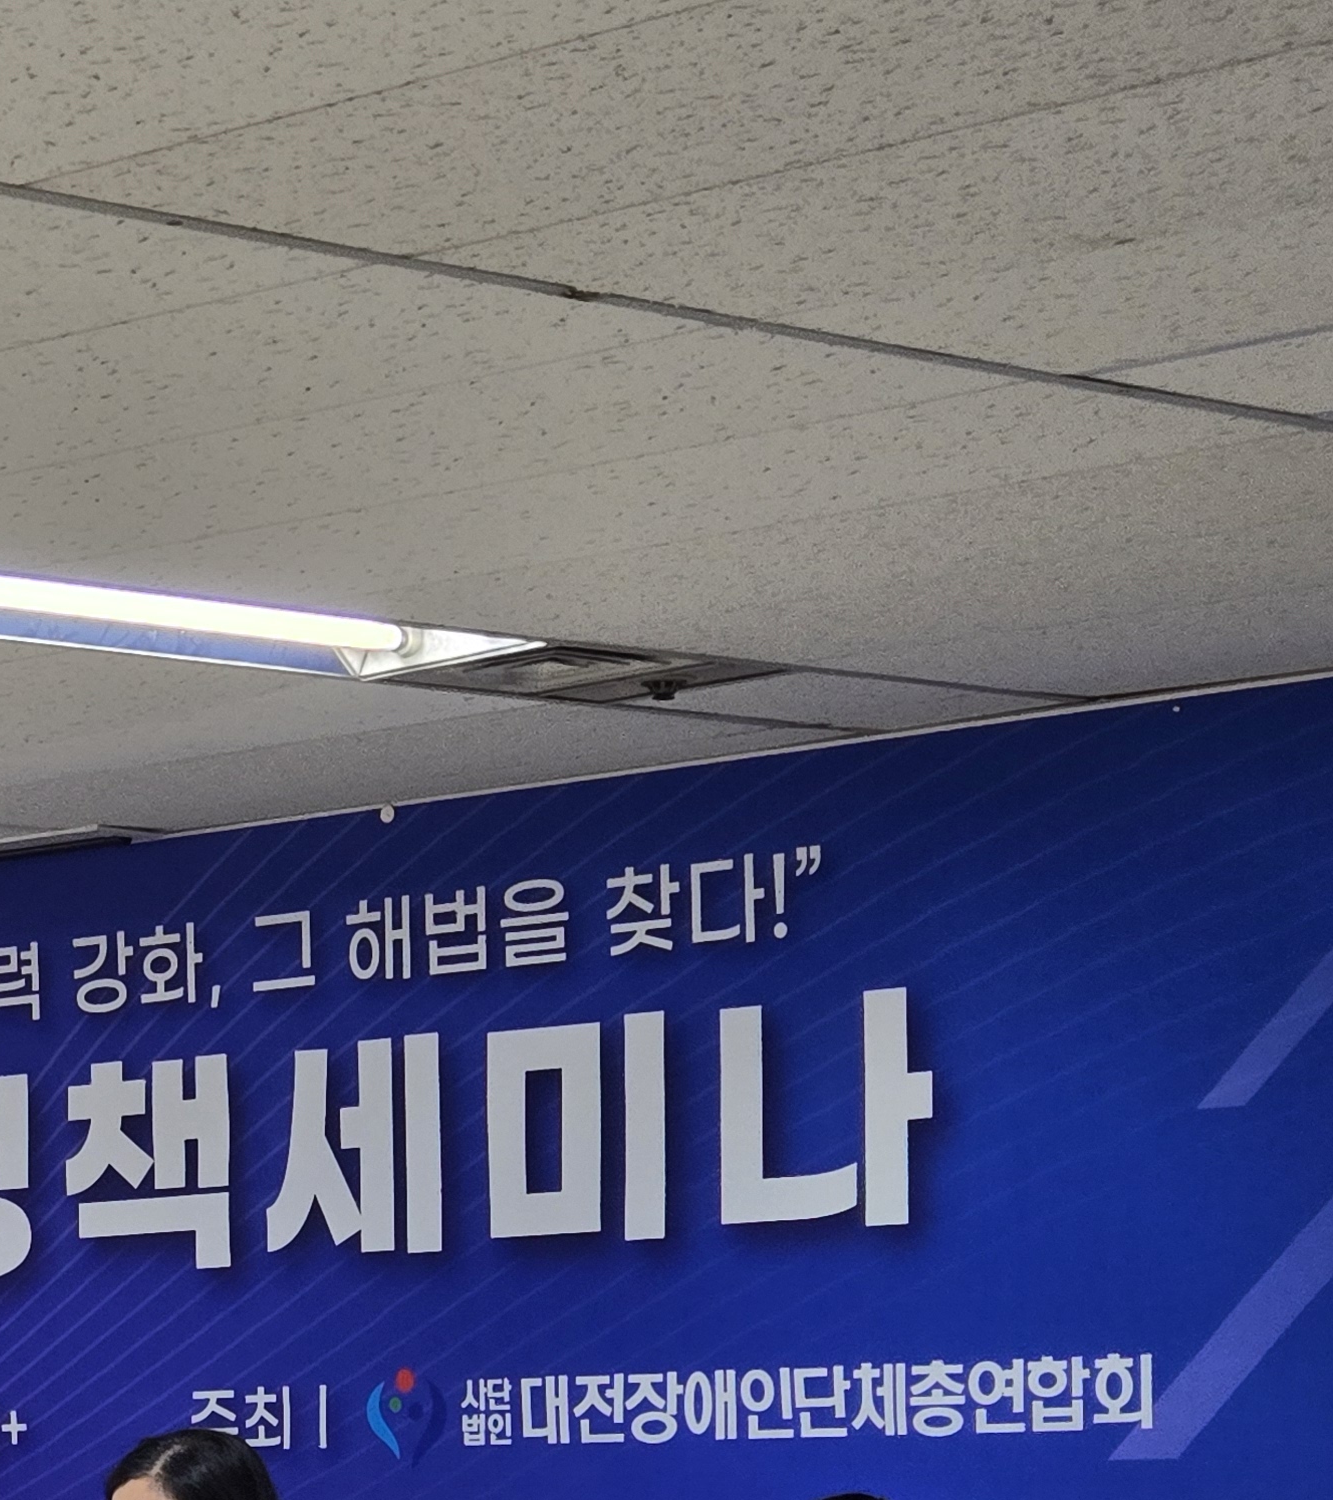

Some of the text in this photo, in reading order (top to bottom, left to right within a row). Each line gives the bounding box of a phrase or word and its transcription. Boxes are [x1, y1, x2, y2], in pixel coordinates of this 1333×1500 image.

[72, 921, 221, 1013] 강화,
[252, 910, 316, 993] 그
[345, 878, 570, 980] 해법을
[606, 844, 822, 957] 찾다!”
[190, 1385, 291, 1450] 주최
[460, 1377, 511, 1405] 사단
[520, 1352, 1154, 1445] 대전장애인단체총연합회
[461, 1408, 511, 1447] 법인
